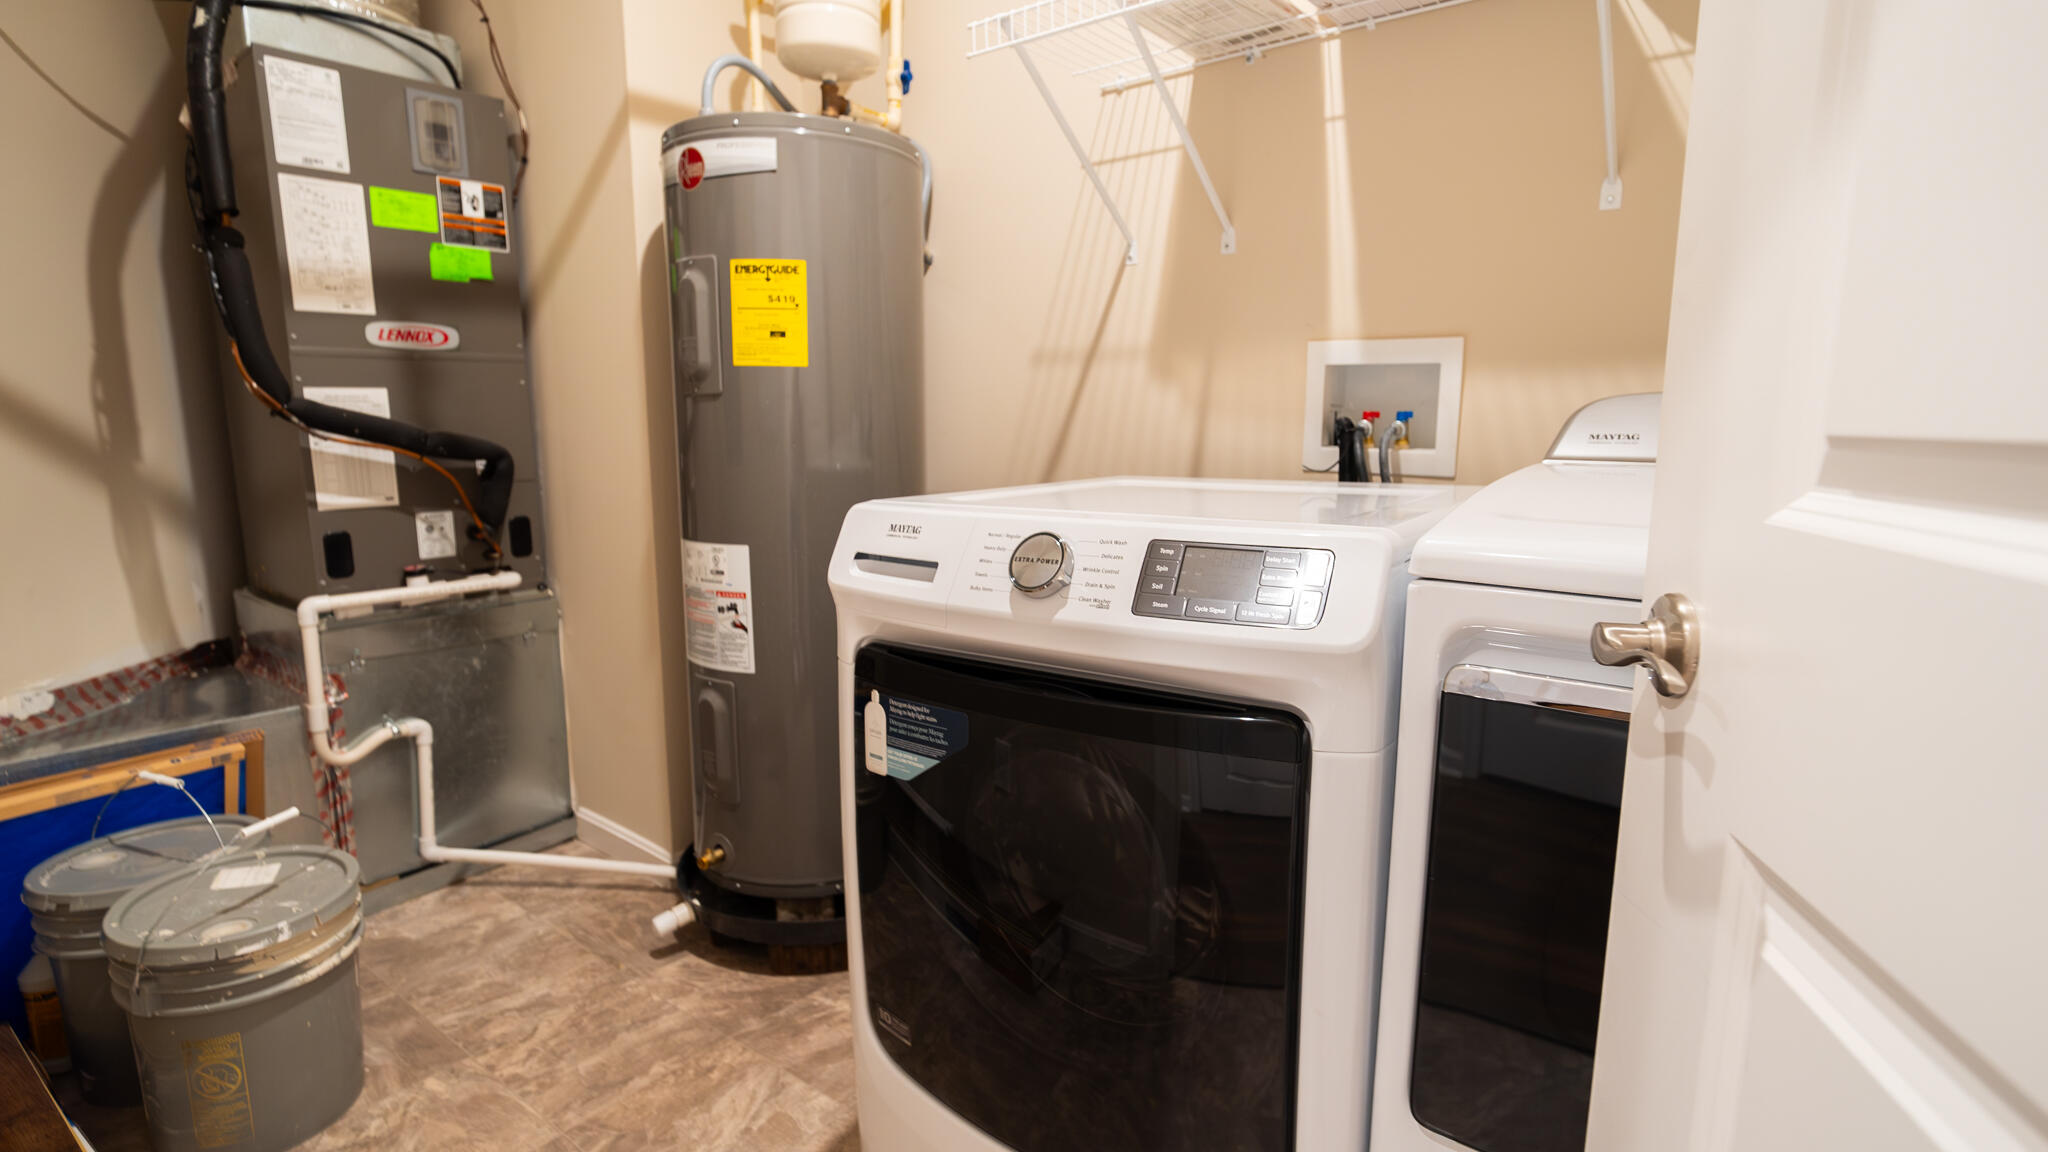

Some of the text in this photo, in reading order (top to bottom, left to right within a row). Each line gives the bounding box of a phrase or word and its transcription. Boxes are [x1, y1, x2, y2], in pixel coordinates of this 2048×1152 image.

[378, 327, 434, 344] LENNOX
[1588, 433, 1640, 441] MAYTAG
[888, 523, 923, 535] MAYTAG
[1160, 547, 1175, 556] Temp
[1014, 556, 1060, 566] EXTRA POWER
[1101, 567, 1120, 575] Control
[1156, 564, 1169, 573] Spin
[1151, 582, 1164, 591] Soil
[1152, 601, 1169, 609] Steam
[1194, 605, 1227, 616] Cycle Signal
